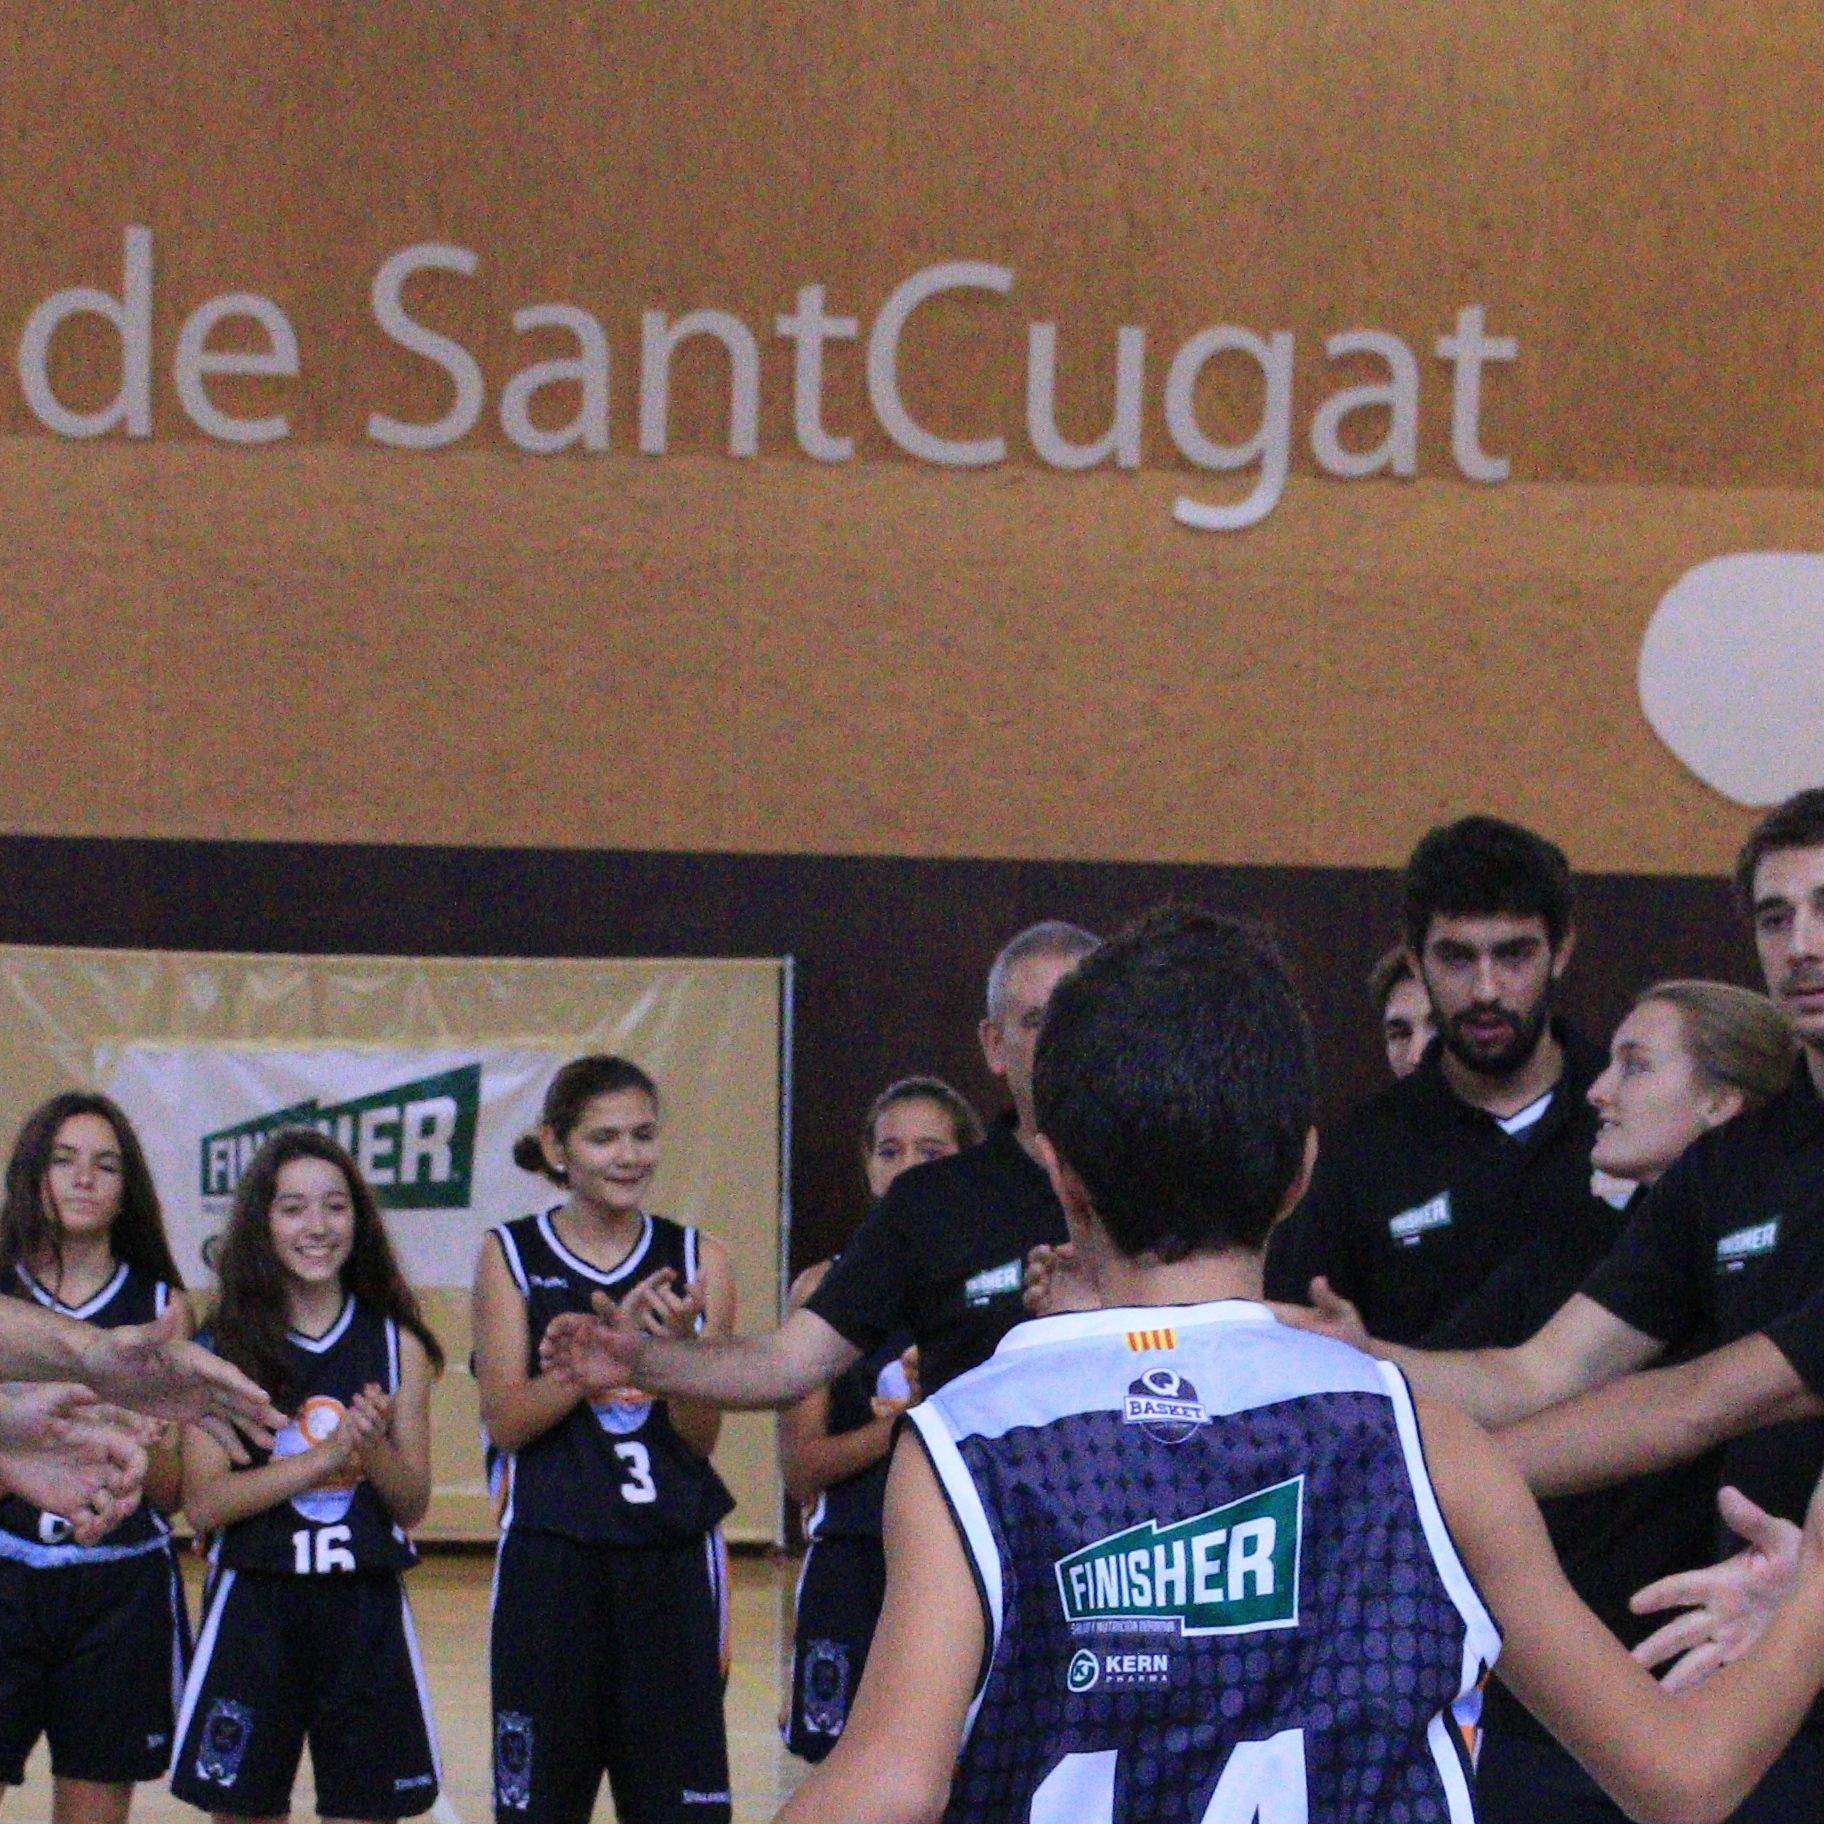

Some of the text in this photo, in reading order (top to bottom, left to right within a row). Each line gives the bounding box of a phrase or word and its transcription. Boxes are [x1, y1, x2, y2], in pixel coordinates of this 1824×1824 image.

[16, 223, 302, 443] de
[366, 240, 1519, 531] SantCugat
[1141, 1366, 1180, 1397] Q
[1129, 1401, 1202, 1419] BASKET
[613, 1440, 658, 1504] 3
[291, 1524, 357, 1575] 16
[1068, 1516, 1278, 1613] FINISHER
[1105, 1654, 1168, 1673] KERN
